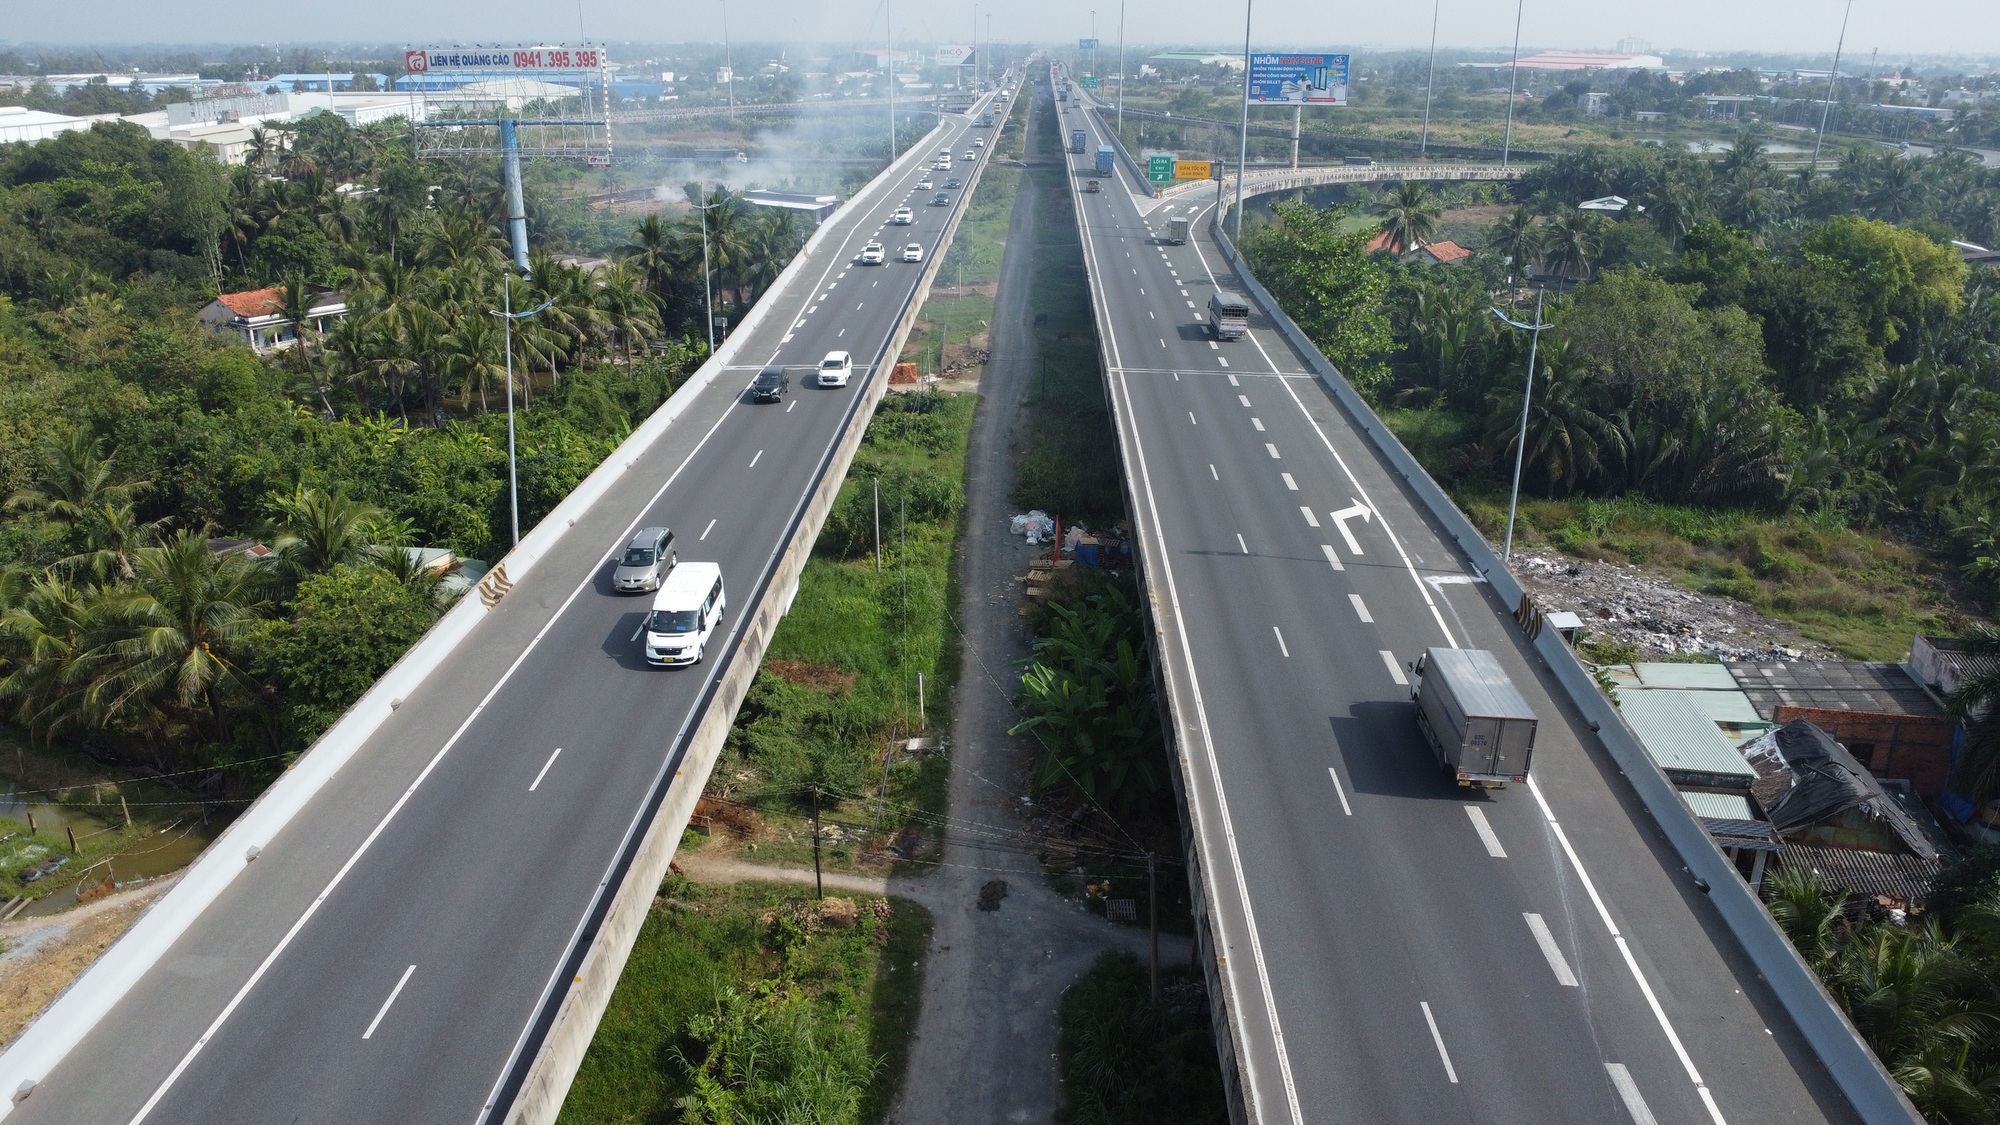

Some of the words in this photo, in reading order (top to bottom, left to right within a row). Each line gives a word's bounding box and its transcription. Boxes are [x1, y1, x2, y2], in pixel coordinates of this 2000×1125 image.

[430, 54, 448, 66] LIÊN
[450, 54, 460, 68] HỆ
[462, 52, 490, 66] QUẢNG
[492, 52, 510, 66] CÁO
[514, 51, 598, 68] 0941.395.395
[1254, 55, 1278, 64] NHÔM
